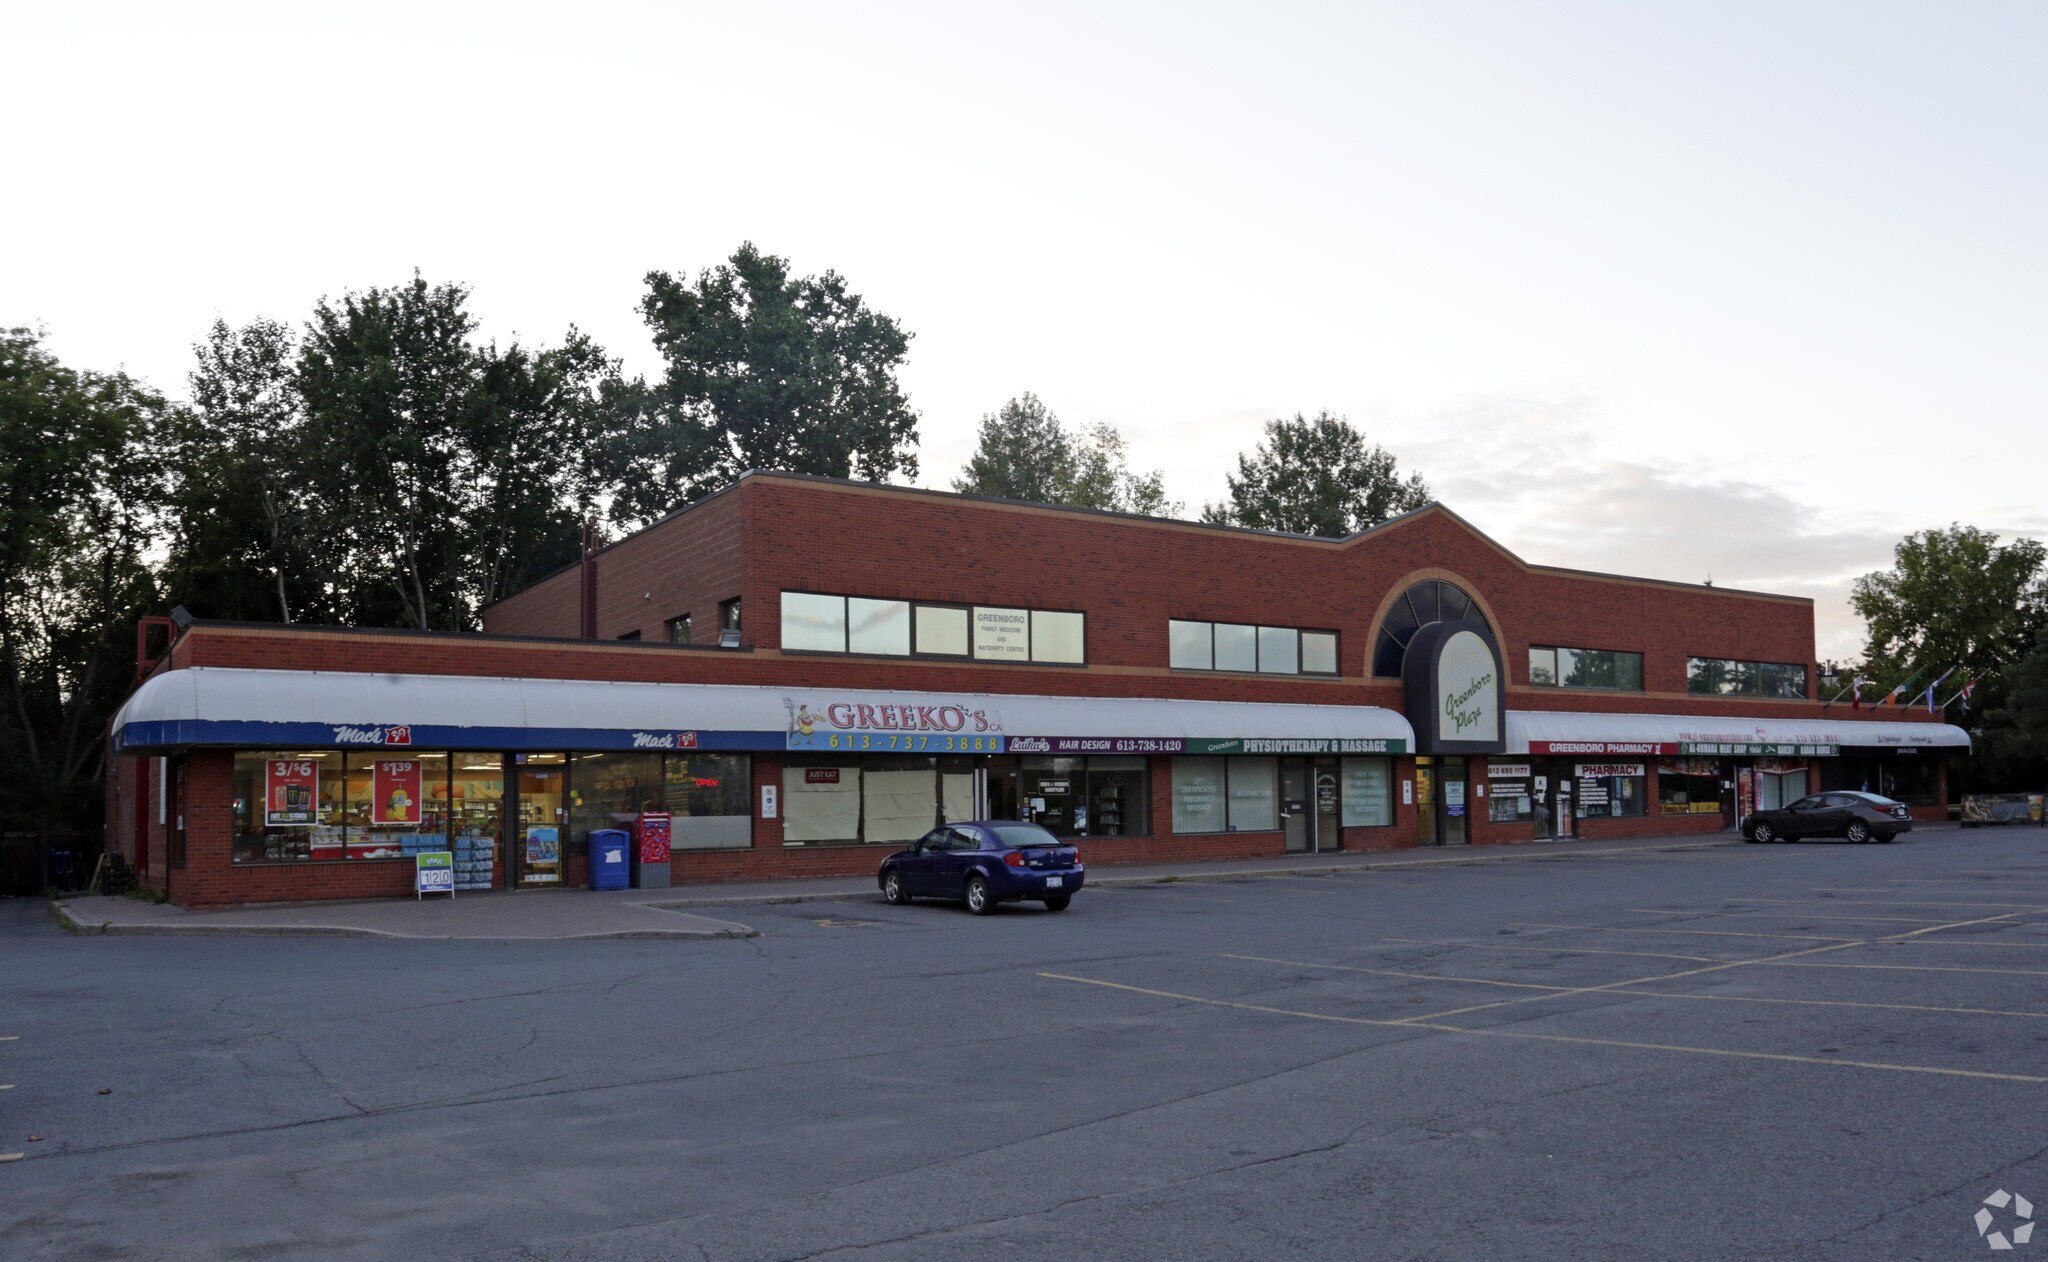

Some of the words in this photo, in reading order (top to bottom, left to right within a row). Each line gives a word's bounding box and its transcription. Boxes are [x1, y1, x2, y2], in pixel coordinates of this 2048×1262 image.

[977, 613, 1024, 624] GREENBORO
[1446, 673, 1491, 720] Greenboro
[1454, 707, 1482, 734] Plaza
[333, 725, 383, 743] Mac's
[632, 732, 674, 748] Mac's
[828, 734, 999, 750] 613-737-3888
[1059, 740, 1078, 750] HAIR
[1081, 740, 1111, 750] DESIGN
[1116, 740, 1182, 752] 613-738-1420
[1207, 740, 1239, 752] Greenboro
[1243, 739, 1329, 752] PHYSIOTHERAPY
[1331, 740, 1339, 752] &
[1341, 740, 1387, 752] MASSAGE
[1549, 742, 1605, 753] GREENBORO
[1607, 743, 1653, 753] PHARMACY
[1733, 744, 1747, 754] SHOP
[275, 762, 312, 777] 3/$6
[1582, 765, 1639, 775] PHARMACY
[695, 778, 719, 787] OPEN
